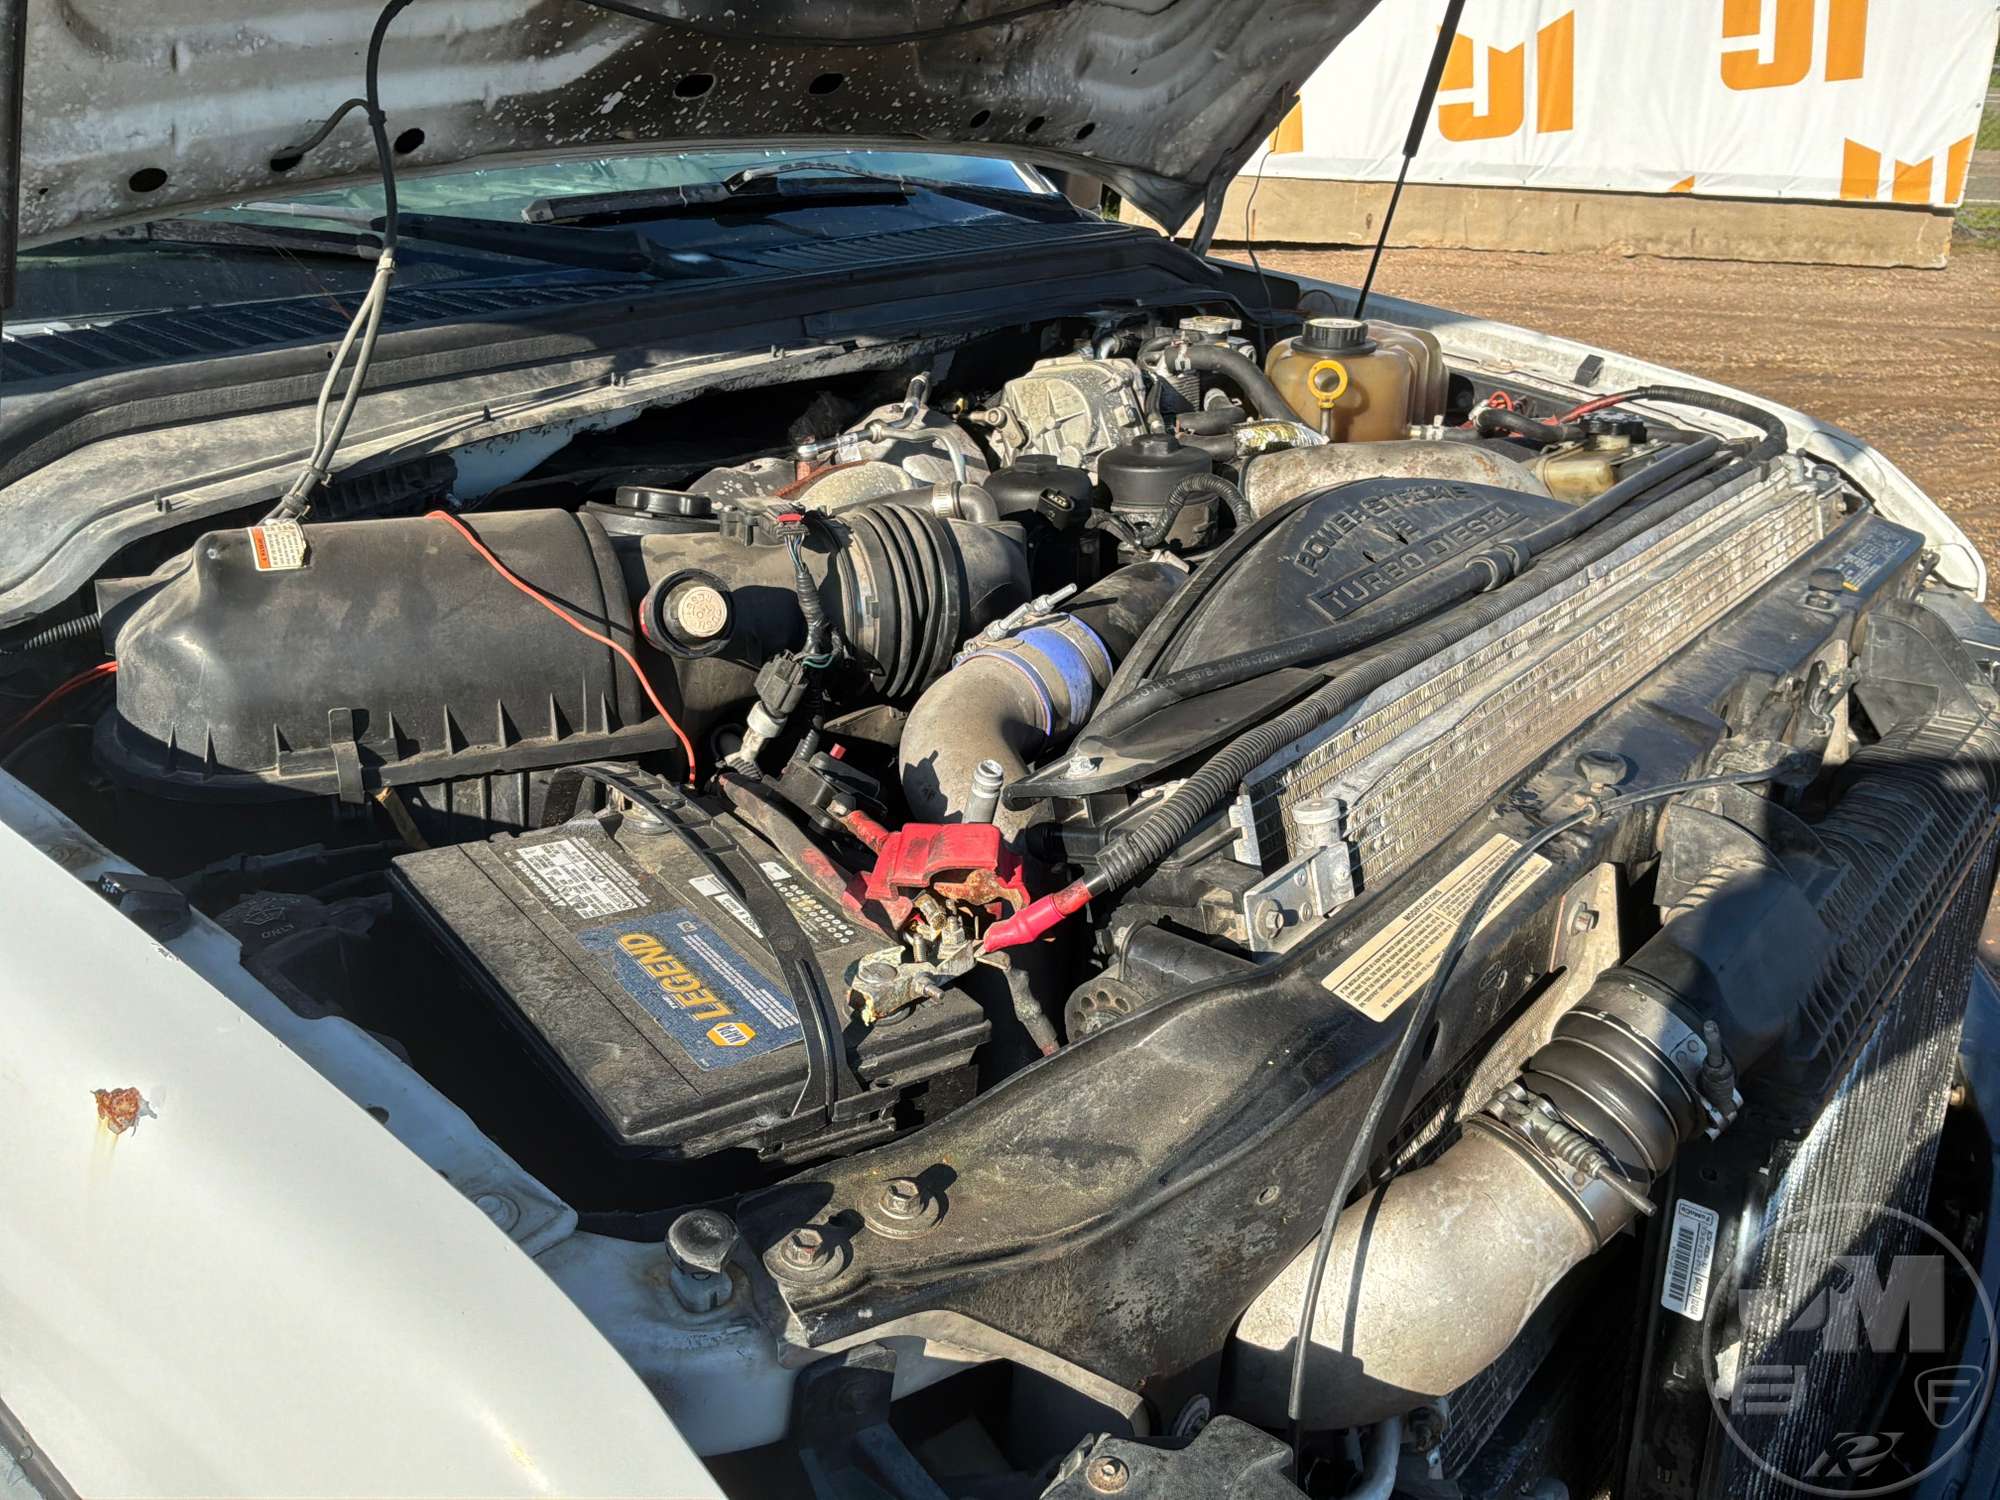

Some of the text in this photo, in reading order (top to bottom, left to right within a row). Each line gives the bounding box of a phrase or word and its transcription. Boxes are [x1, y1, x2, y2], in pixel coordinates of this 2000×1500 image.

[1319, 506, 1522, 609] TURBO DIESEL
[1402, 889, 1443, 922] MODIFICATIONS
[616, 934, 734, 1021] LEGEND
[717, 1024, 745, 1043] NAPA
